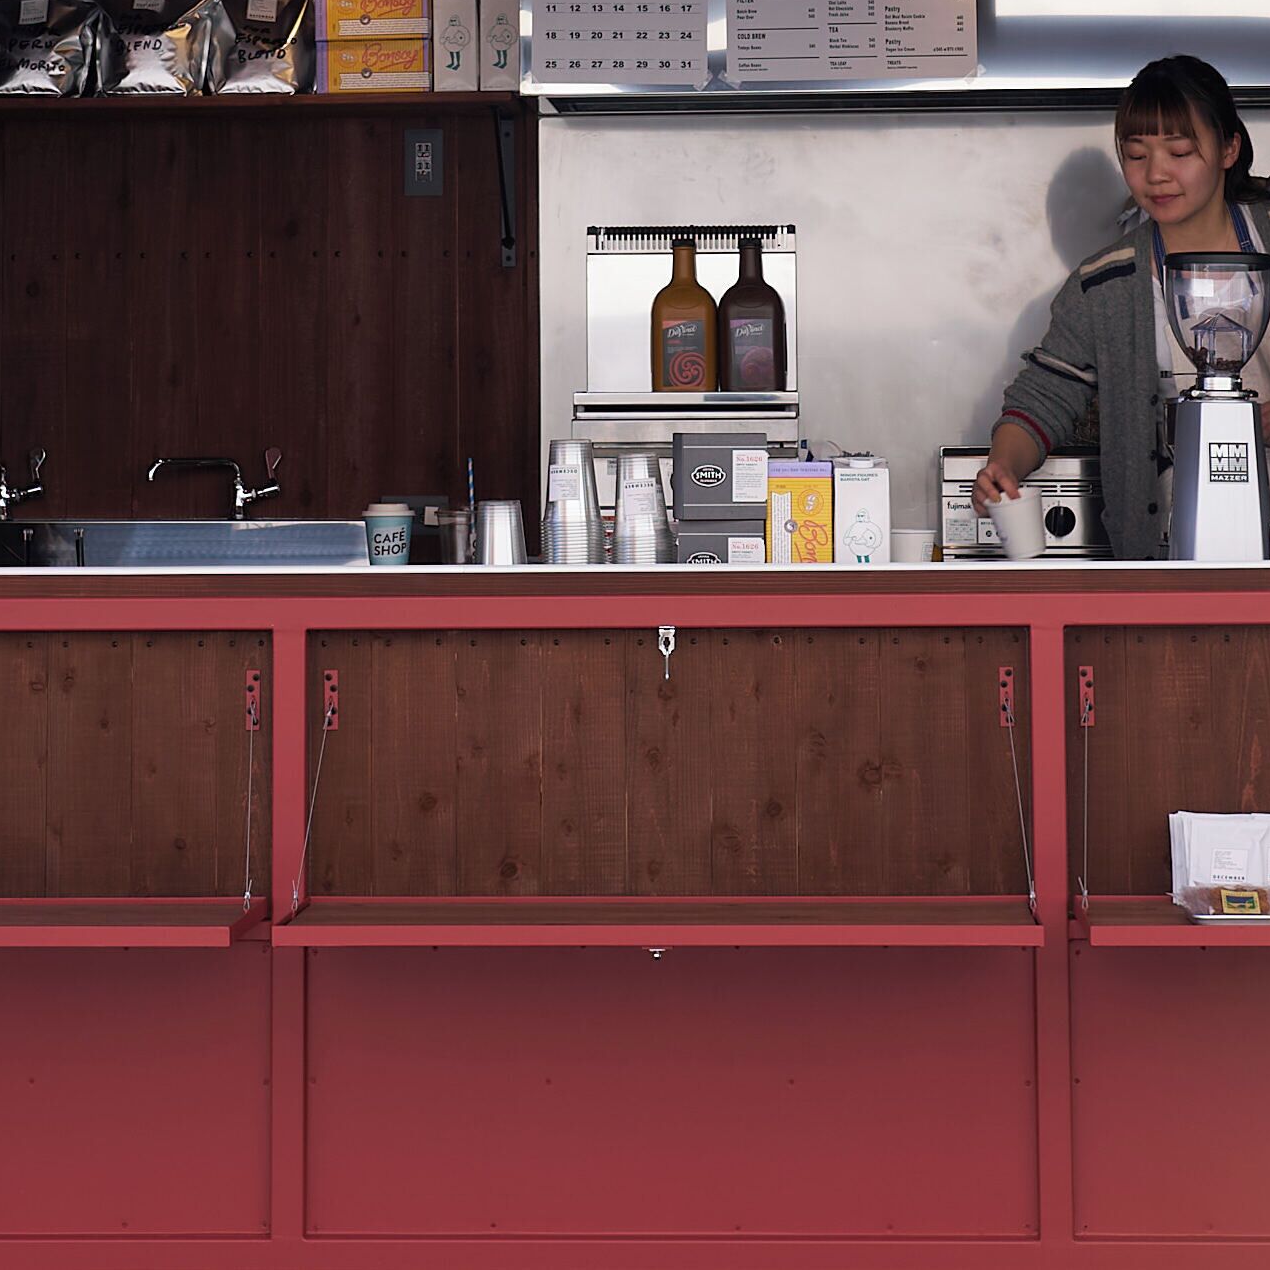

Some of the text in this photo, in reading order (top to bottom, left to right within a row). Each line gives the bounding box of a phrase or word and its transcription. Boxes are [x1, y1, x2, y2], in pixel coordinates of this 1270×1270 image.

[885, 38, 901, 46] Pastry
[695, 472, 722, 480] SMITH
[947, 501, 972, 510] fujimak
[374, 527, 406, 544] CAFÉ
[374, 543, 407, 556] SHOP
